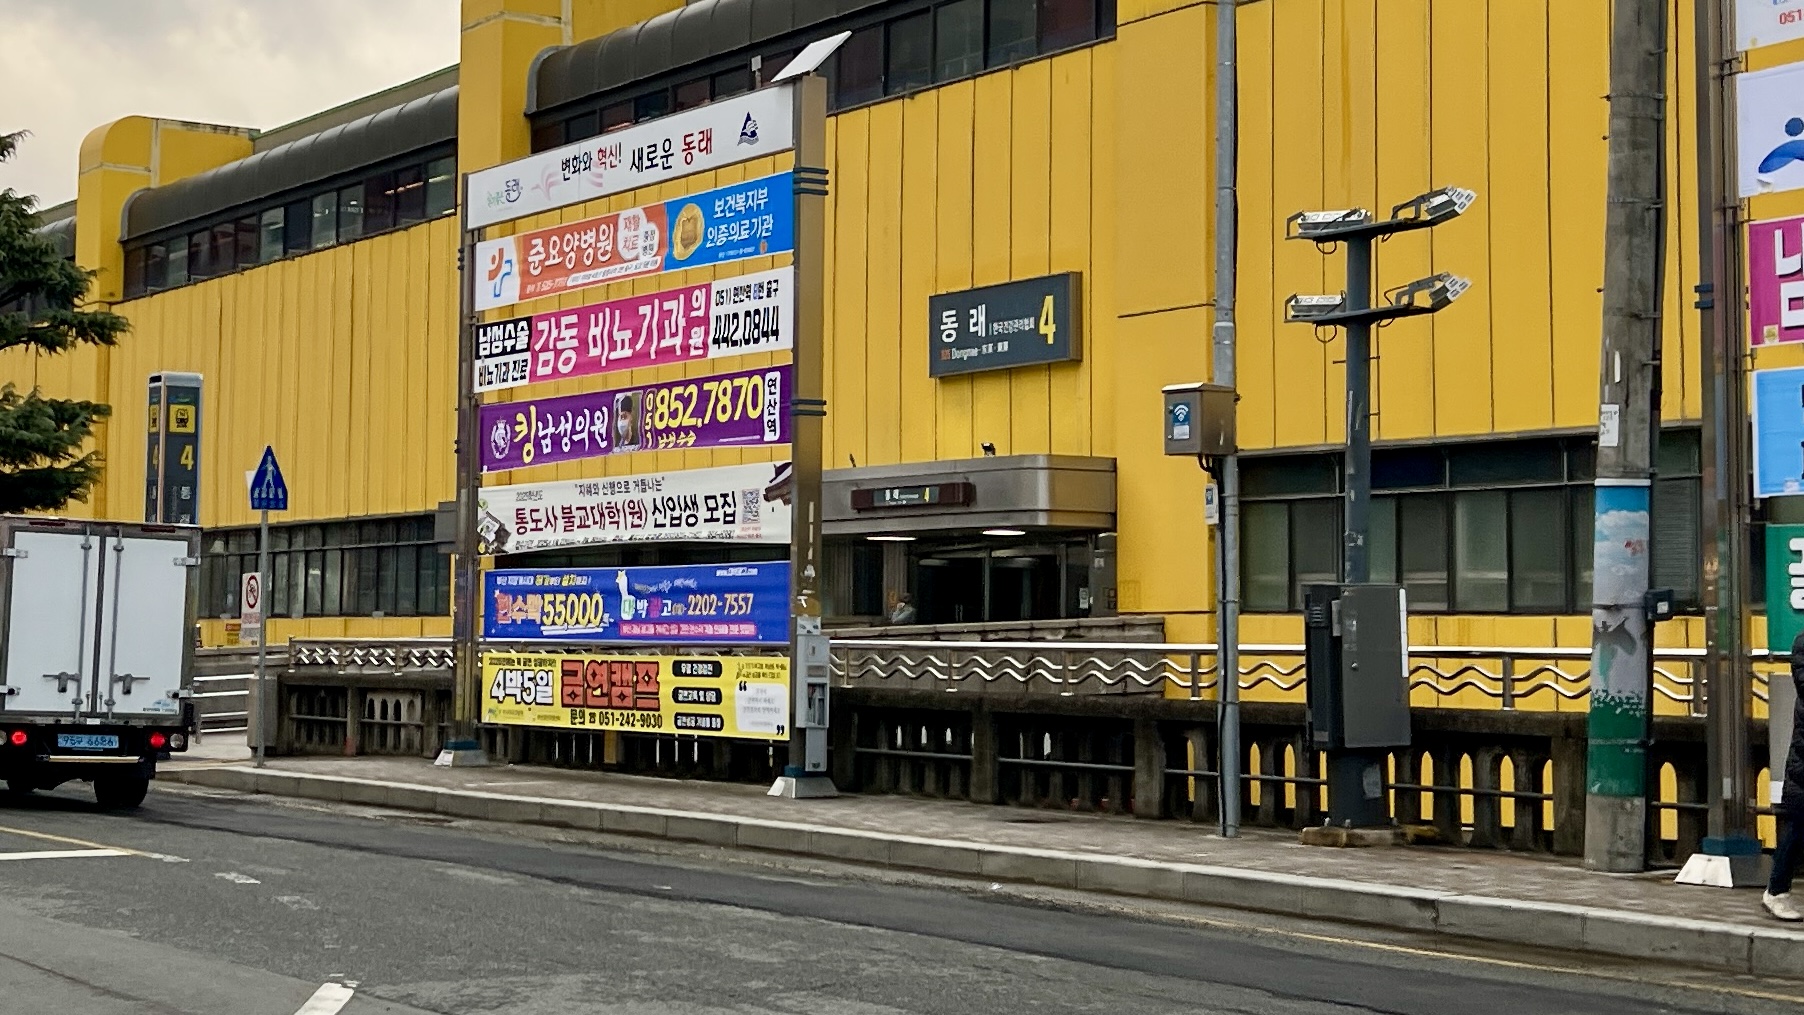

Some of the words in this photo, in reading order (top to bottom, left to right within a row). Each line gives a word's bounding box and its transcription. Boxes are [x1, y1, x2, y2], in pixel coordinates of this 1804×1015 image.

[561, 151, 593, 182] 변화와
[597, 142, 622, 170] 혁신!
[630, 138, 674, 173] 새로운
[681, 128, 713, 166] 동래
[713, 186, 768, 219] 보건복지부
[527, 223, 614, 276] 준요양병원
[705, 213, 774, 248] 인증의료기관
[479, 320, 529, 356] 남성수술
[534, 314, 580, 376] 감동
[587, 293, 686, 367] 비뇨기과
[1038, 295, 1057, 345] 4
[766, 376, 778, 436] 연산역
[180, 444, 194, 471] 4
[515, 505, 558, 535] 통도사
[561, 498, 648, 533] 불교대학(원)
[652, 493, 699, 528] 신입생
[703, 490, 737, 525] 모집
[686, 593, 754, 616] 2202-7557
[490, 668, 554, 706] 4박5일
[561, 659, 660, 712] 금연캠프
[570, 709, 585, 725] 문의
[599, 711, 663, 729] 051-242-9030
